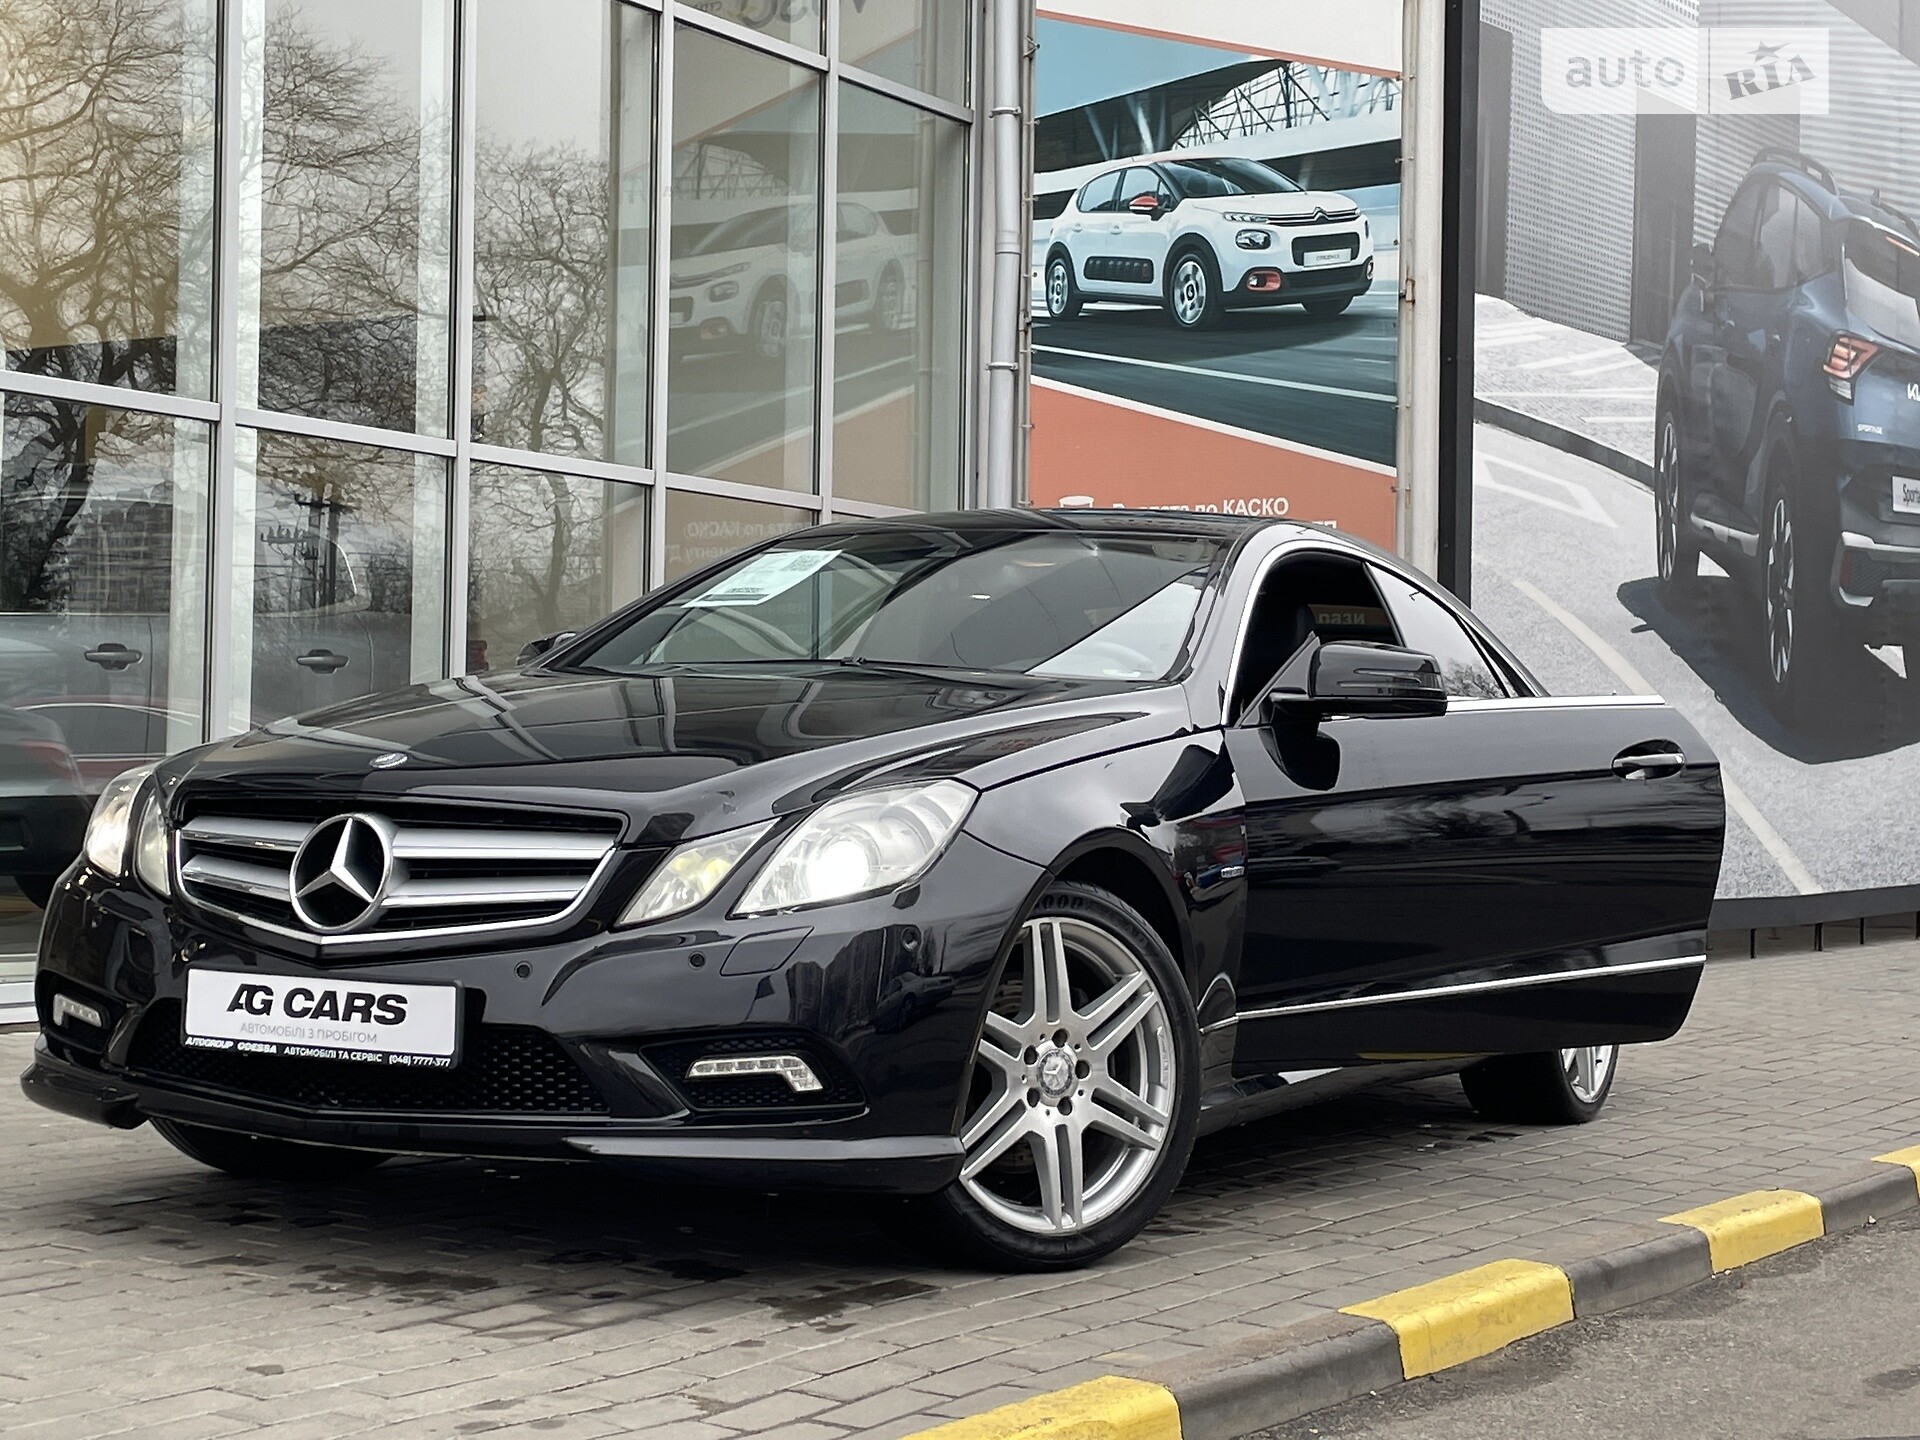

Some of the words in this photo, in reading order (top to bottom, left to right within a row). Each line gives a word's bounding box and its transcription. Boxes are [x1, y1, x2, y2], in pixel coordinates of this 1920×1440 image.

[1223, 497, 1289, 516] КАСКО
[226, 983, 274, 1016] AG
[283, 987, 408, 1026] CARS
[240, 1022, 306, 1038] АВТОМОБІЛІ
[309, 1028, 315, 1038] З
[317, 1030, 377, 1043] ПРОБІГОМ
[284, 1046, 336, 1058] АВТОМОБІЛІ
[338, 1050, 349, 1060] ТА
[350, 1051, 382, 1062] СЕРВІС
